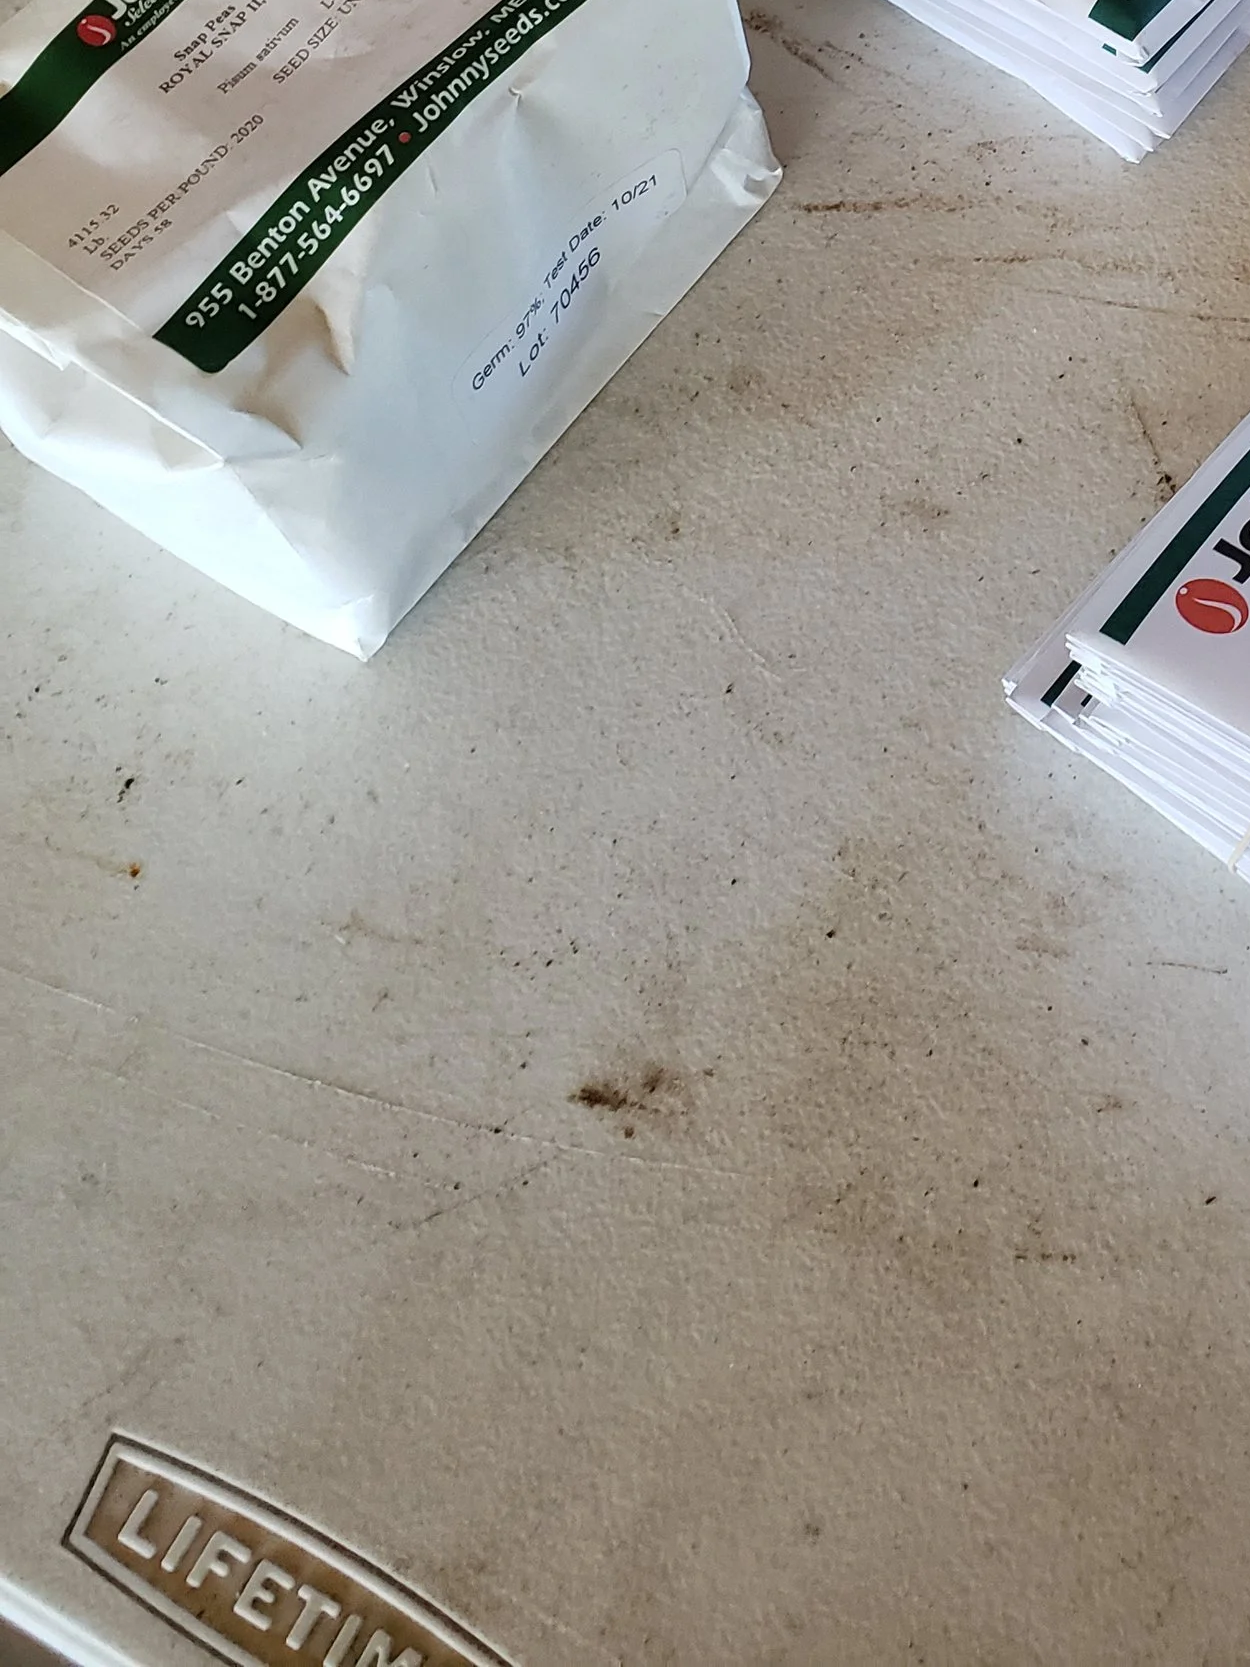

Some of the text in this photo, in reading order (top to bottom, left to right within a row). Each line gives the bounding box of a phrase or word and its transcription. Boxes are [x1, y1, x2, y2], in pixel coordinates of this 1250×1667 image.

[158, 43, 214, 96] ROYAL
[208, 8, 252, 49] SNAP
[173, 1, 238, 64] Snap Peas
[216, 15, 302, 96] Pisum sativum
[270, 44, 313, 84] SEED
[183, 279, 235, 333] 955
[226, 197, 317, 286] Benton
[301, 109, 398, 203] Avenue,
[388, 23, 494, 114] Winslow,
[234, 143, 402, 322] 1-877-564-6697
[470, 173, 657, 391] Germ: 97%; Test Date: 10/21
[514, 243, 603, 377] Lot: 70456
